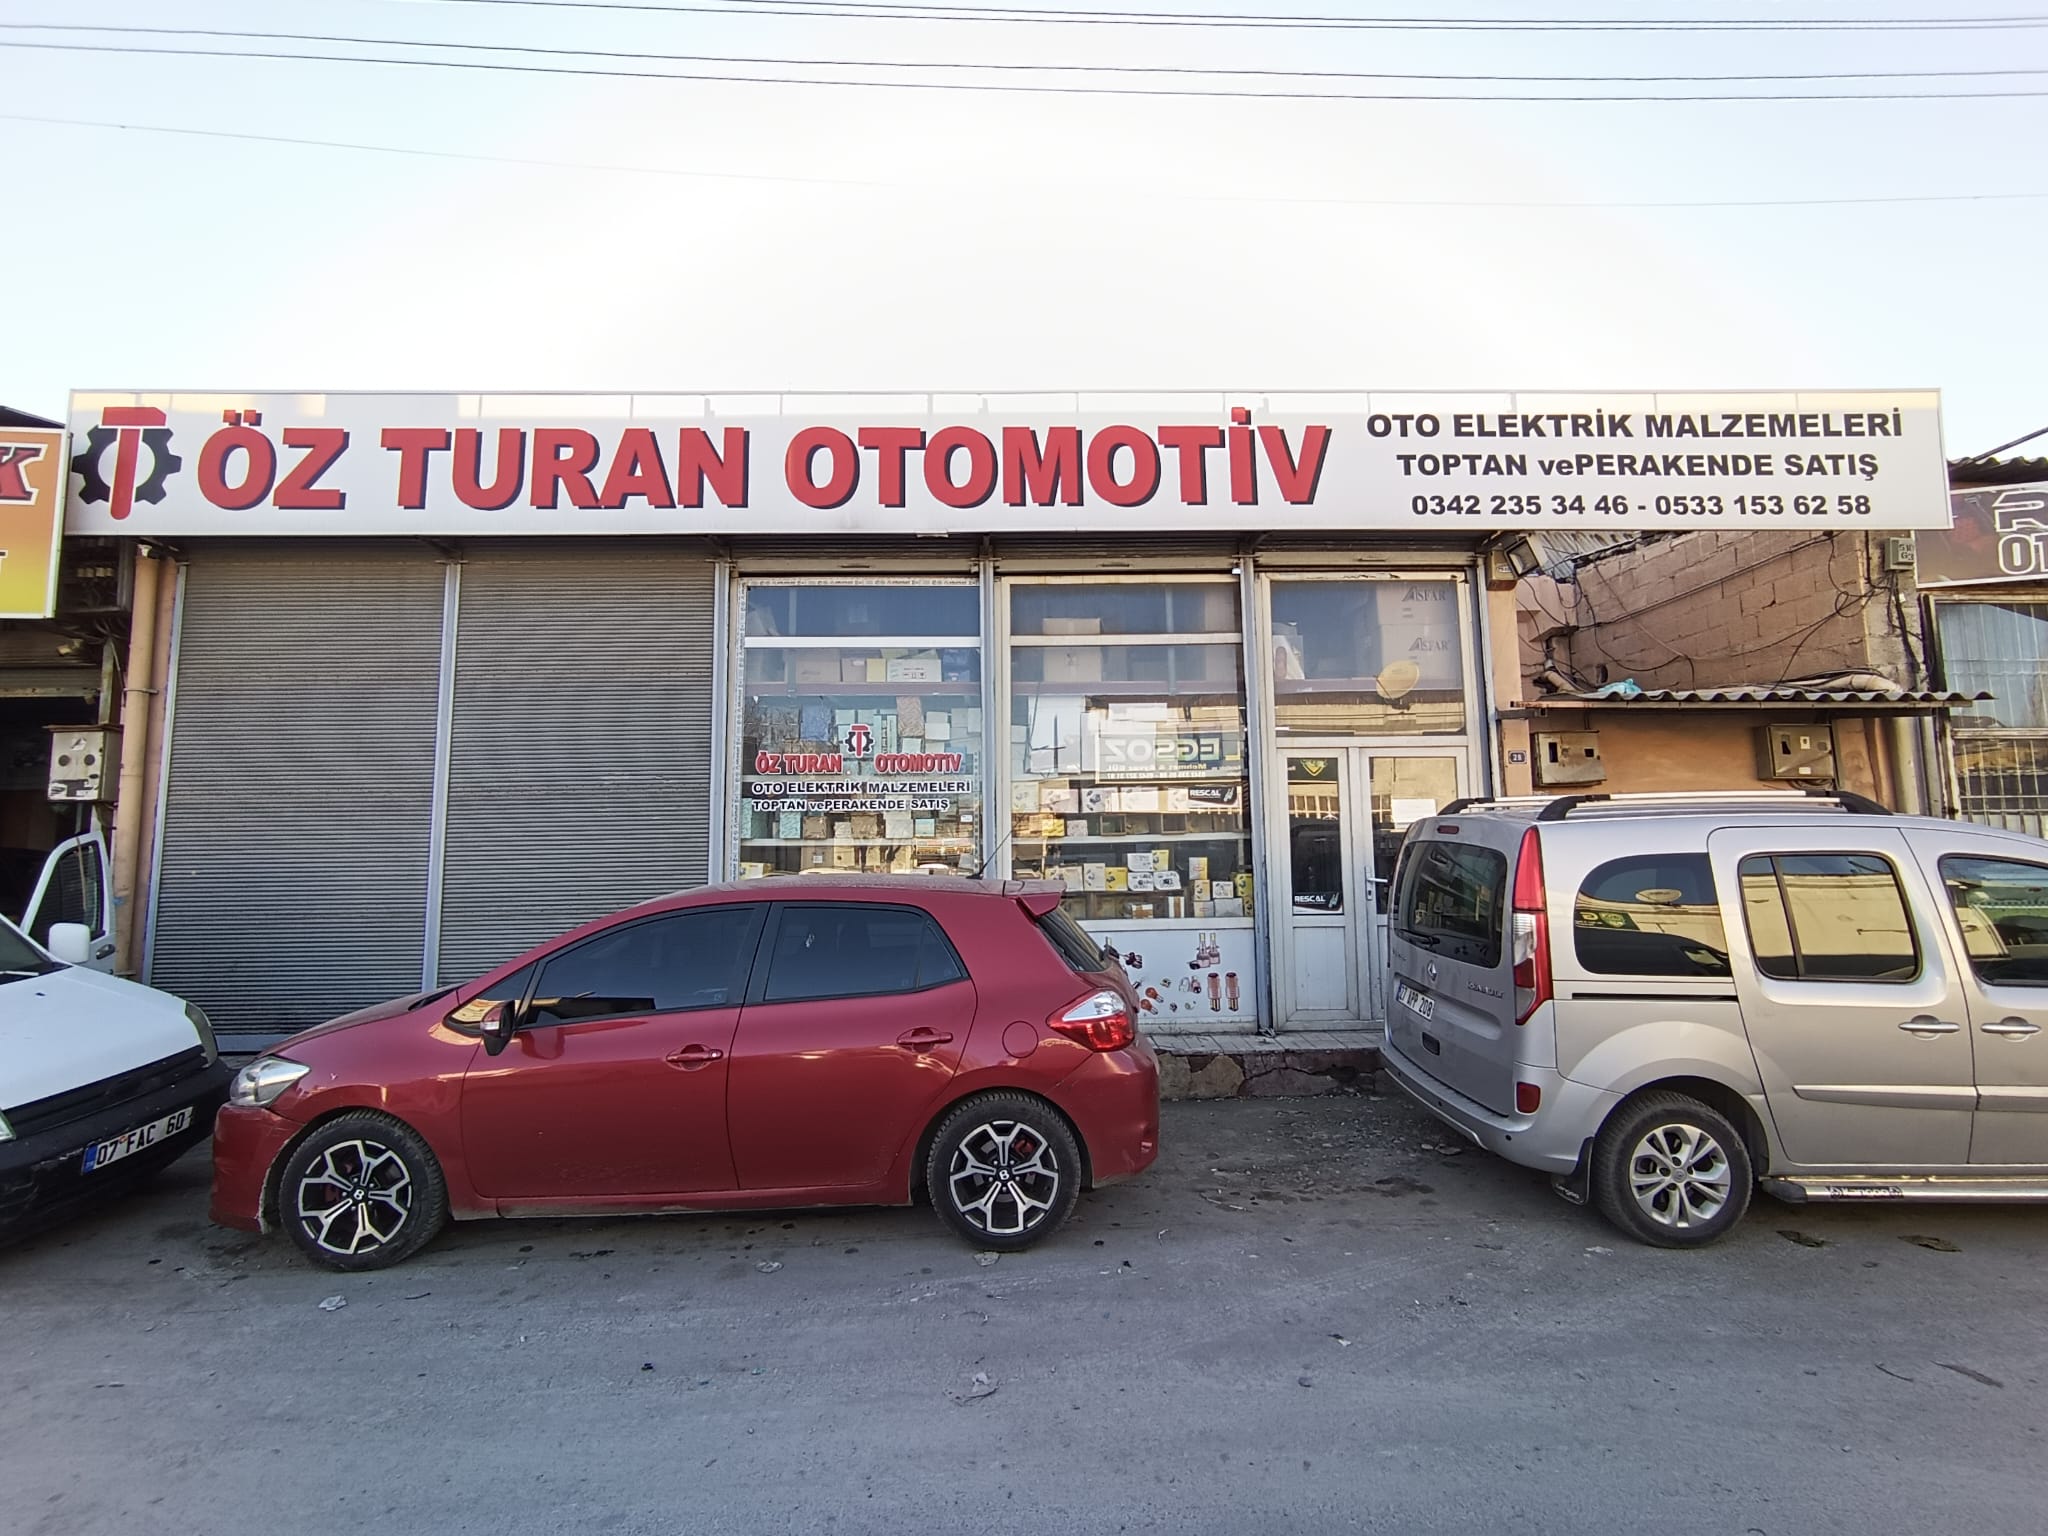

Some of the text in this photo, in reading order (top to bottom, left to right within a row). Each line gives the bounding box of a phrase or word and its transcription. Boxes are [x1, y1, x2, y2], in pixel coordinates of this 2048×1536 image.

[1367, 407, 1902, 438] OTO ELEKTRİK MALZEMELERİ
[198, 407, 1333, 512] ÖZ TURAN OTOMOTİV
[1396, 454, 1527, 476] TOPTAN
[1784, 453, 1879, 481] SATIŞ
[1411, 495, 1481, 515] 0342
[1490, 495, 1542, 515] 235
[1551, 495, 1586, 515] 34
[1594, 495, 1629, 515] 46
[1655, 495, 1724, 516] 0533
[1734, 495, 1784, 515] 153
[1793, 495, 1828, 515] 62
[1837, 495, 1871, 515] 58
[756, 751, 781, 774] ÖZ
[784, 754, 843, 774] TURAN
[753, 780, 970, 793] OTO ELEKTRİK MALZEMELERİ
[753, 800, 806, 810] TOPTAN
[911, 799, 949, 812] SATIŞ
[96, 1112, 186, 1167] 07 FAC 60
